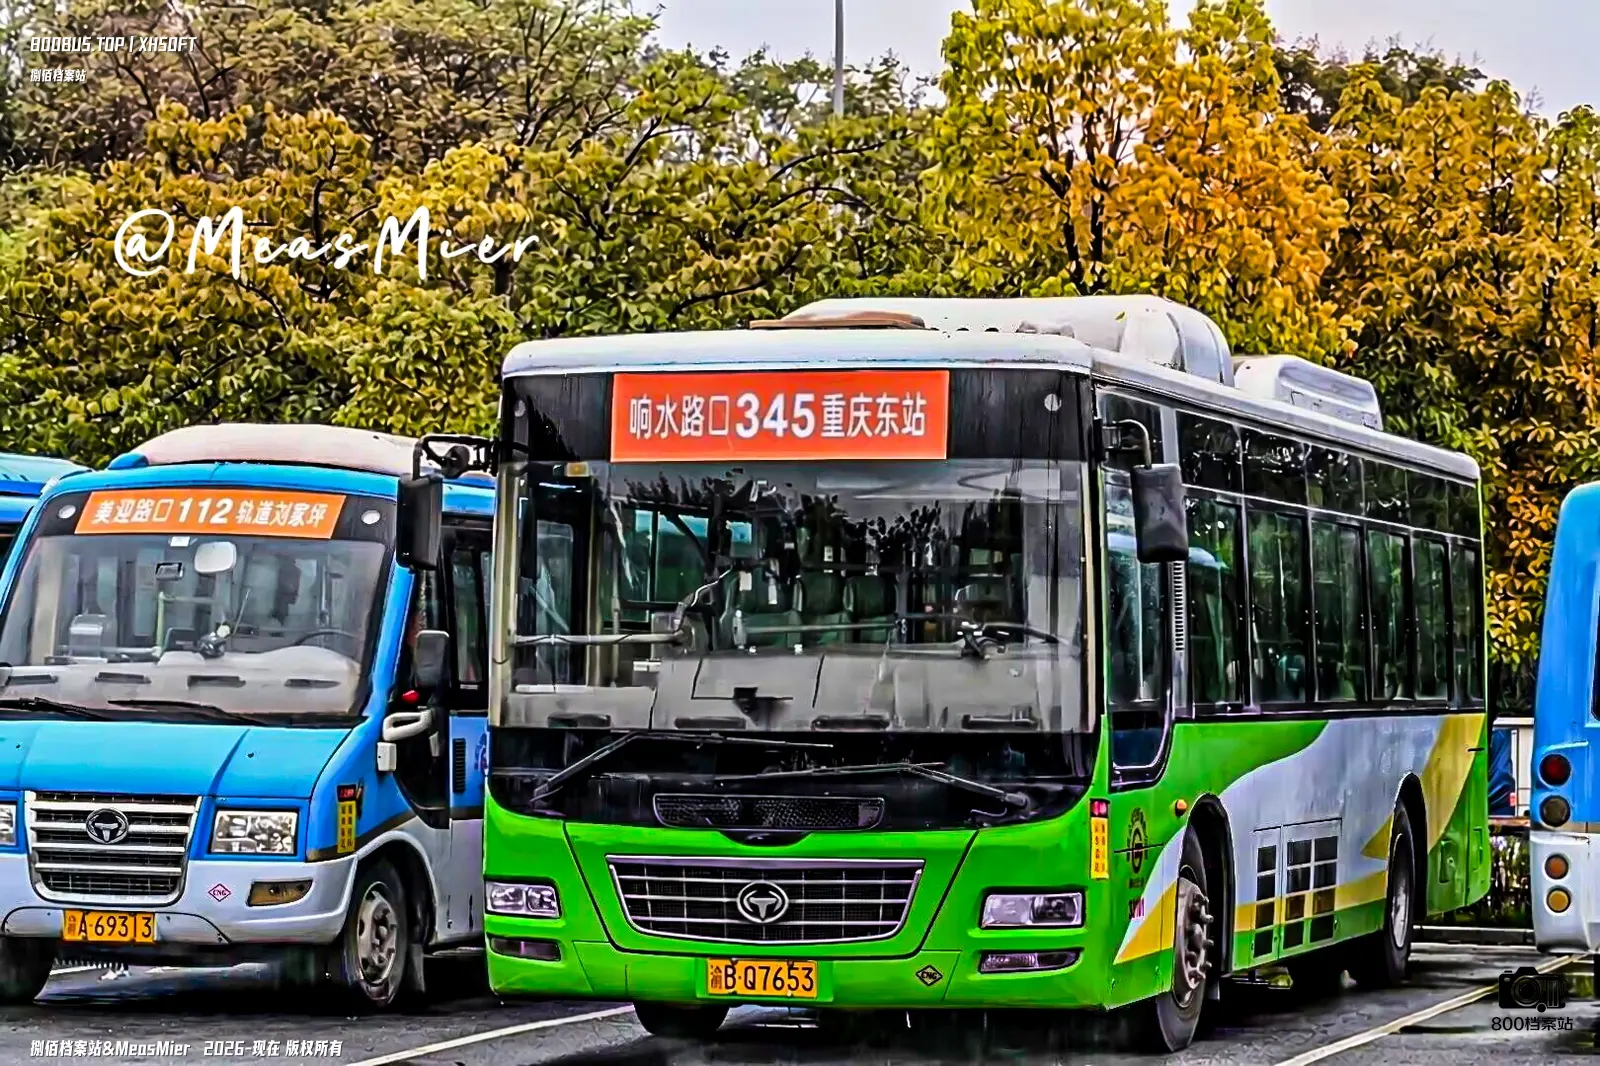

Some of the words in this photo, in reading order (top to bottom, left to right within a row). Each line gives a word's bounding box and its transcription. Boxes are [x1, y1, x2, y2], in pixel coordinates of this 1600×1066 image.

[629, 394, 730, 440] 响水路口
[735, 392, 816, 438] 345
[820, 392, 928, 438] 重庆东站
[177, 497, 234, 524] 112
[235, 499, 329, 528] 轨道刘家坪
[920, 970, 938, 980] CNG
